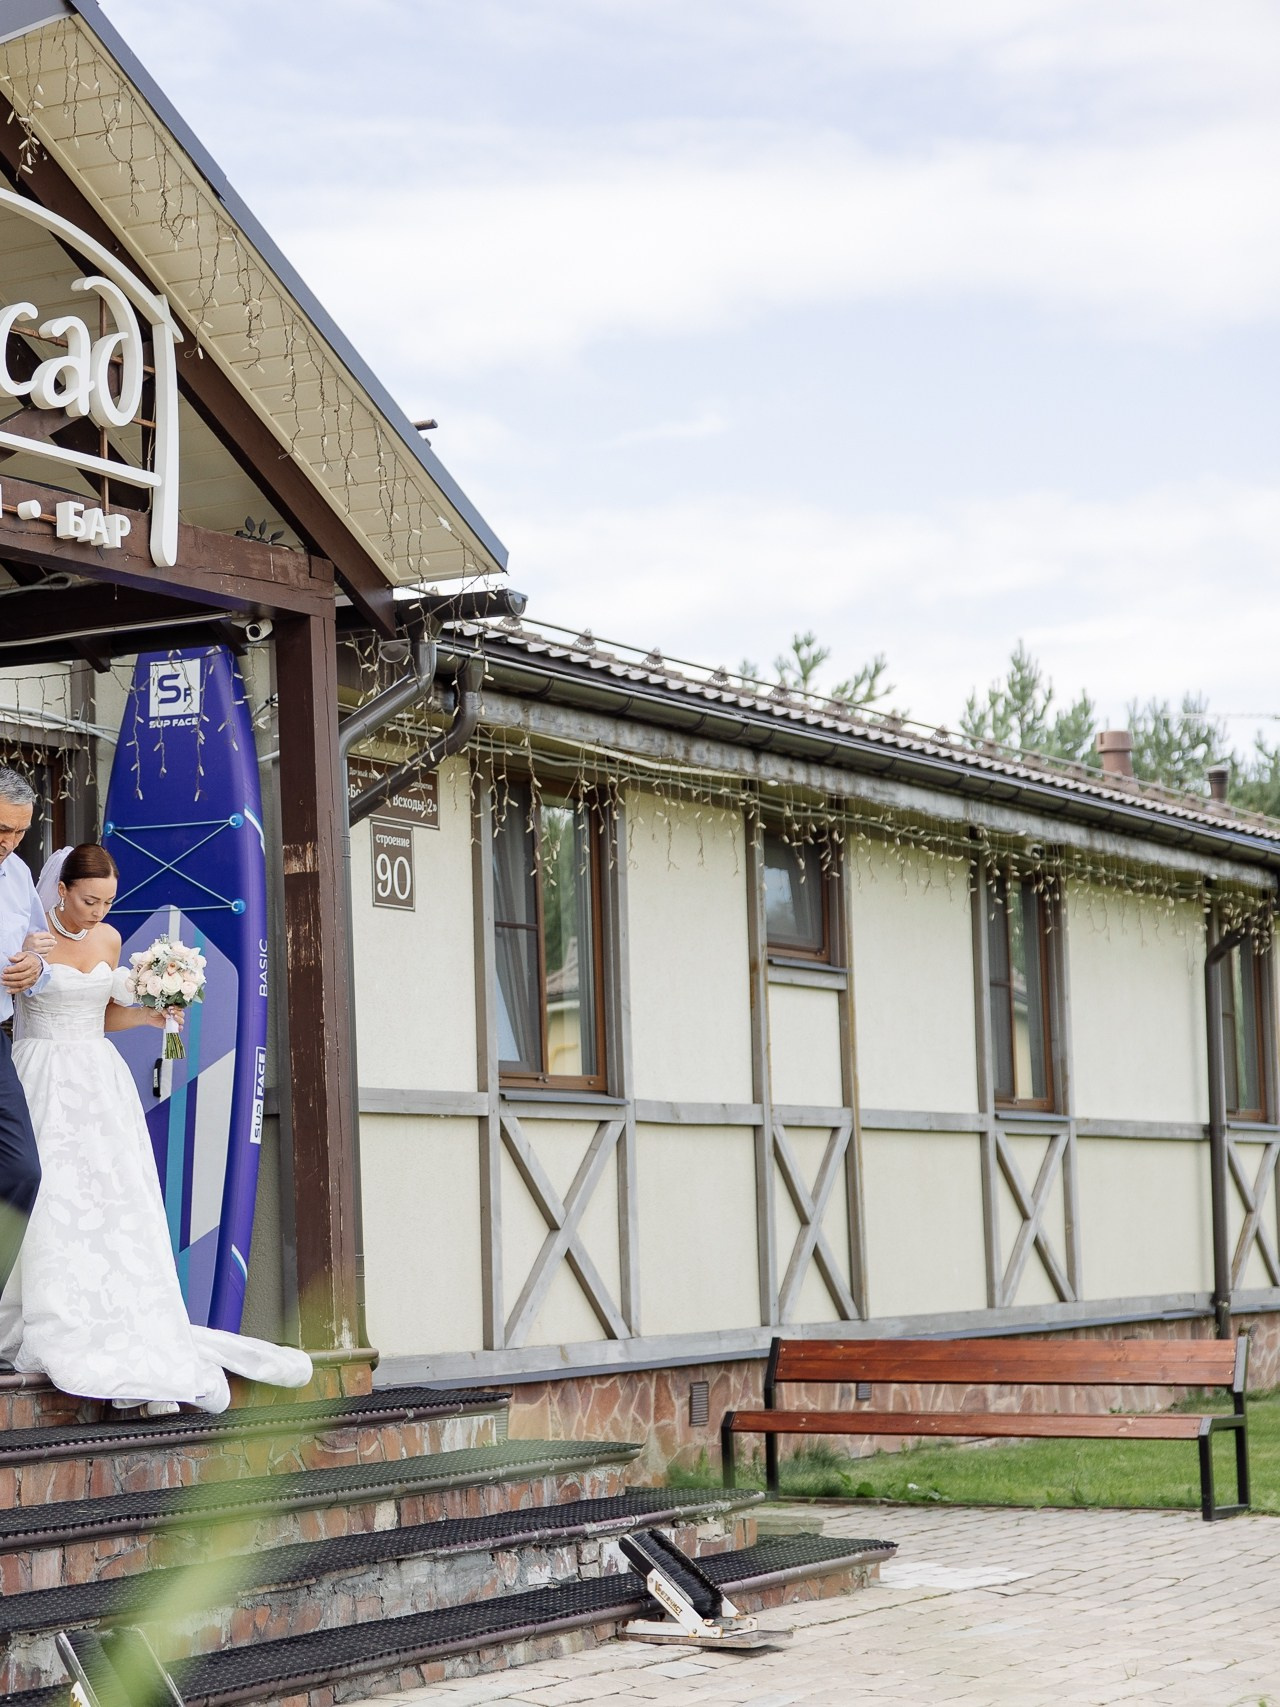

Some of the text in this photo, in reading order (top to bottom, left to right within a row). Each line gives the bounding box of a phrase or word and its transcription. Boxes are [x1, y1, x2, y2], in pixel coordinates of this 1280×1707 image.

[55, 500, 132, 550] БАР
[149, 718, 198, 729] SUP FACE
[375, 833, 410, 848] строение
[376, 853, 411, 900] 90
[259, 938, 268, 997] BASIC
[257, 1052, 266, 1096] FACE
